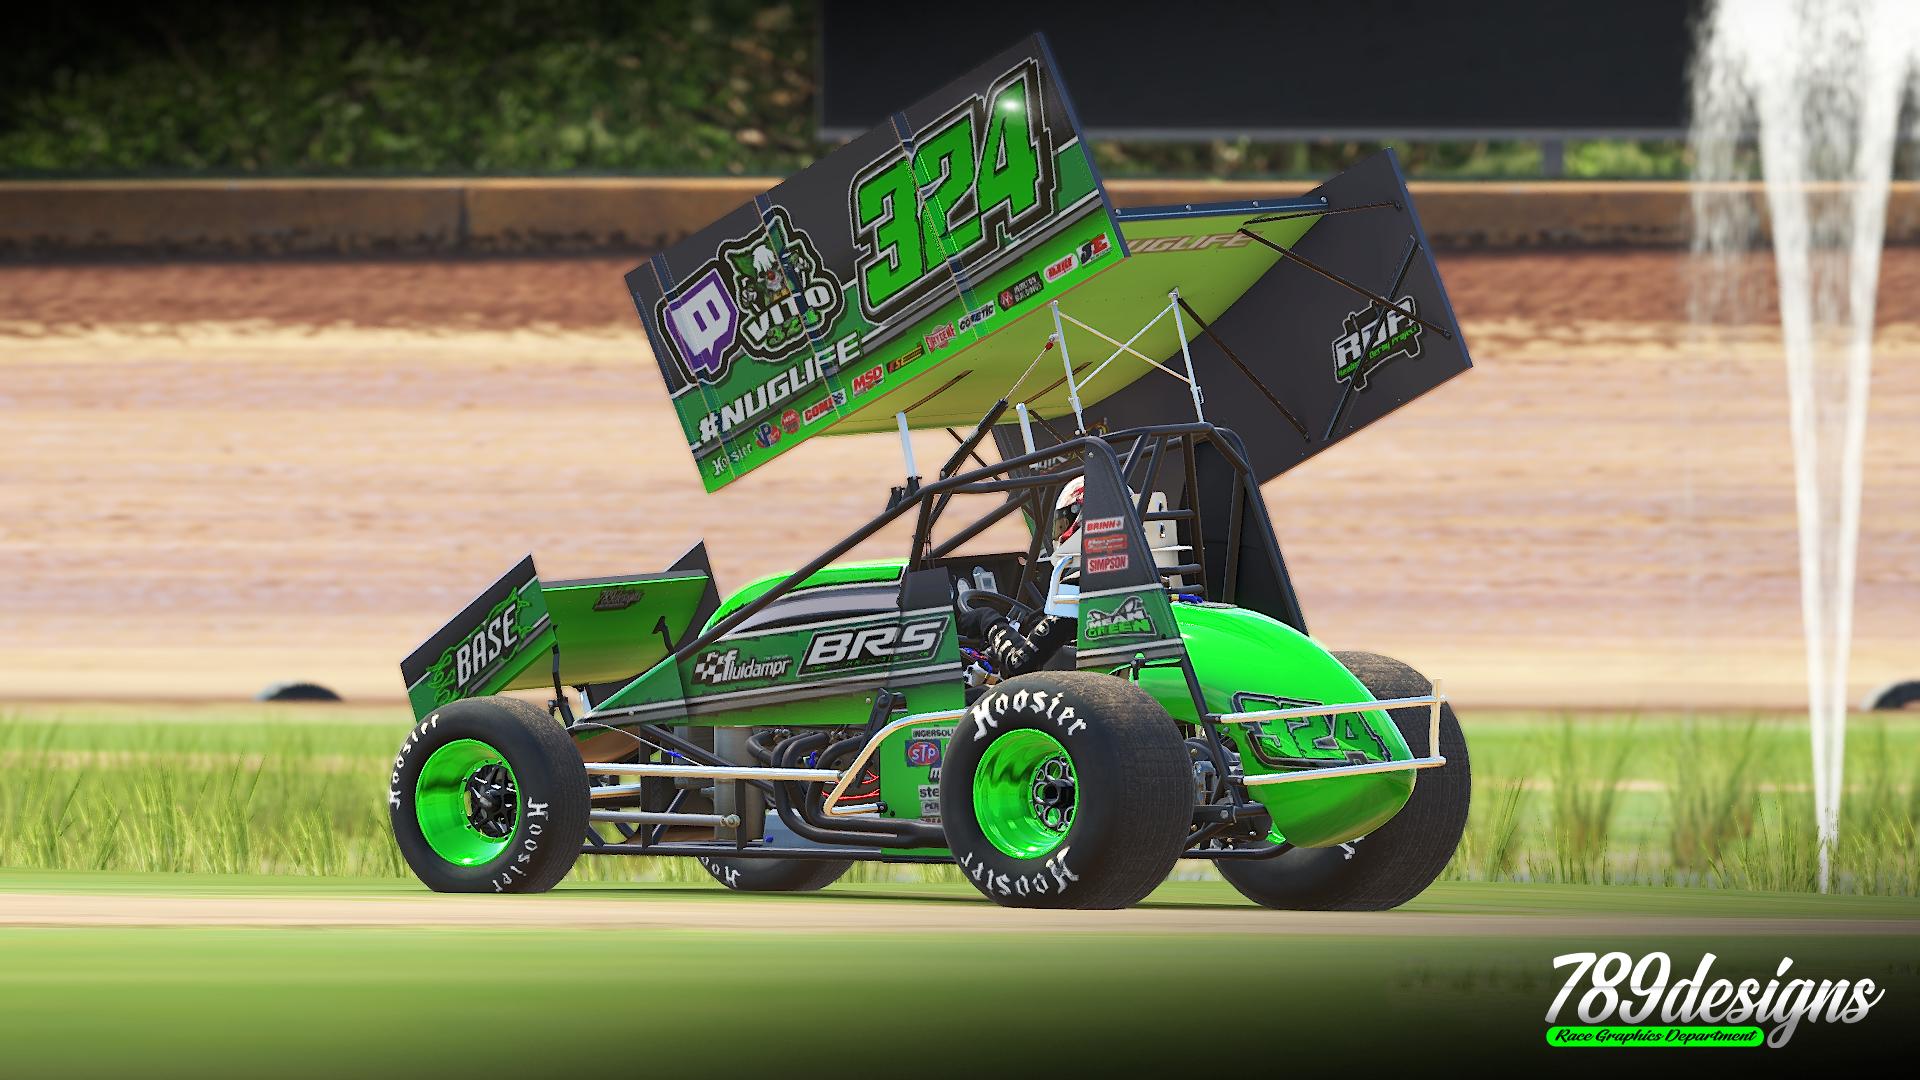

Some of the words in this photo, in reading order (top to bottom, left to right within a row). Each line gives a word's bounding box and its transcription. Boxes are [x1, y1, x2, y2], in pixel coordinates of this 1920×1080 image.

[854, 68, 1046, 314] 324
[747, 286, 830, 341] VITO
[699, 332, 861, 441] #NUGLIFE
[853, 366, 883, 391] MSD
[1089, 556, 1126, 573] SIMPSON
[456, 603, 518, 688] BASE
[805, 621, 942, 666] BRS
[1087, 618, 1152, 638] GREEN
[722, 650, 790, 682] fluidampr
[970, 688, 1087, 742] Hoosier
[911, 743, 937, 762] STP
[492, 796, 549, 892] Hoosier
